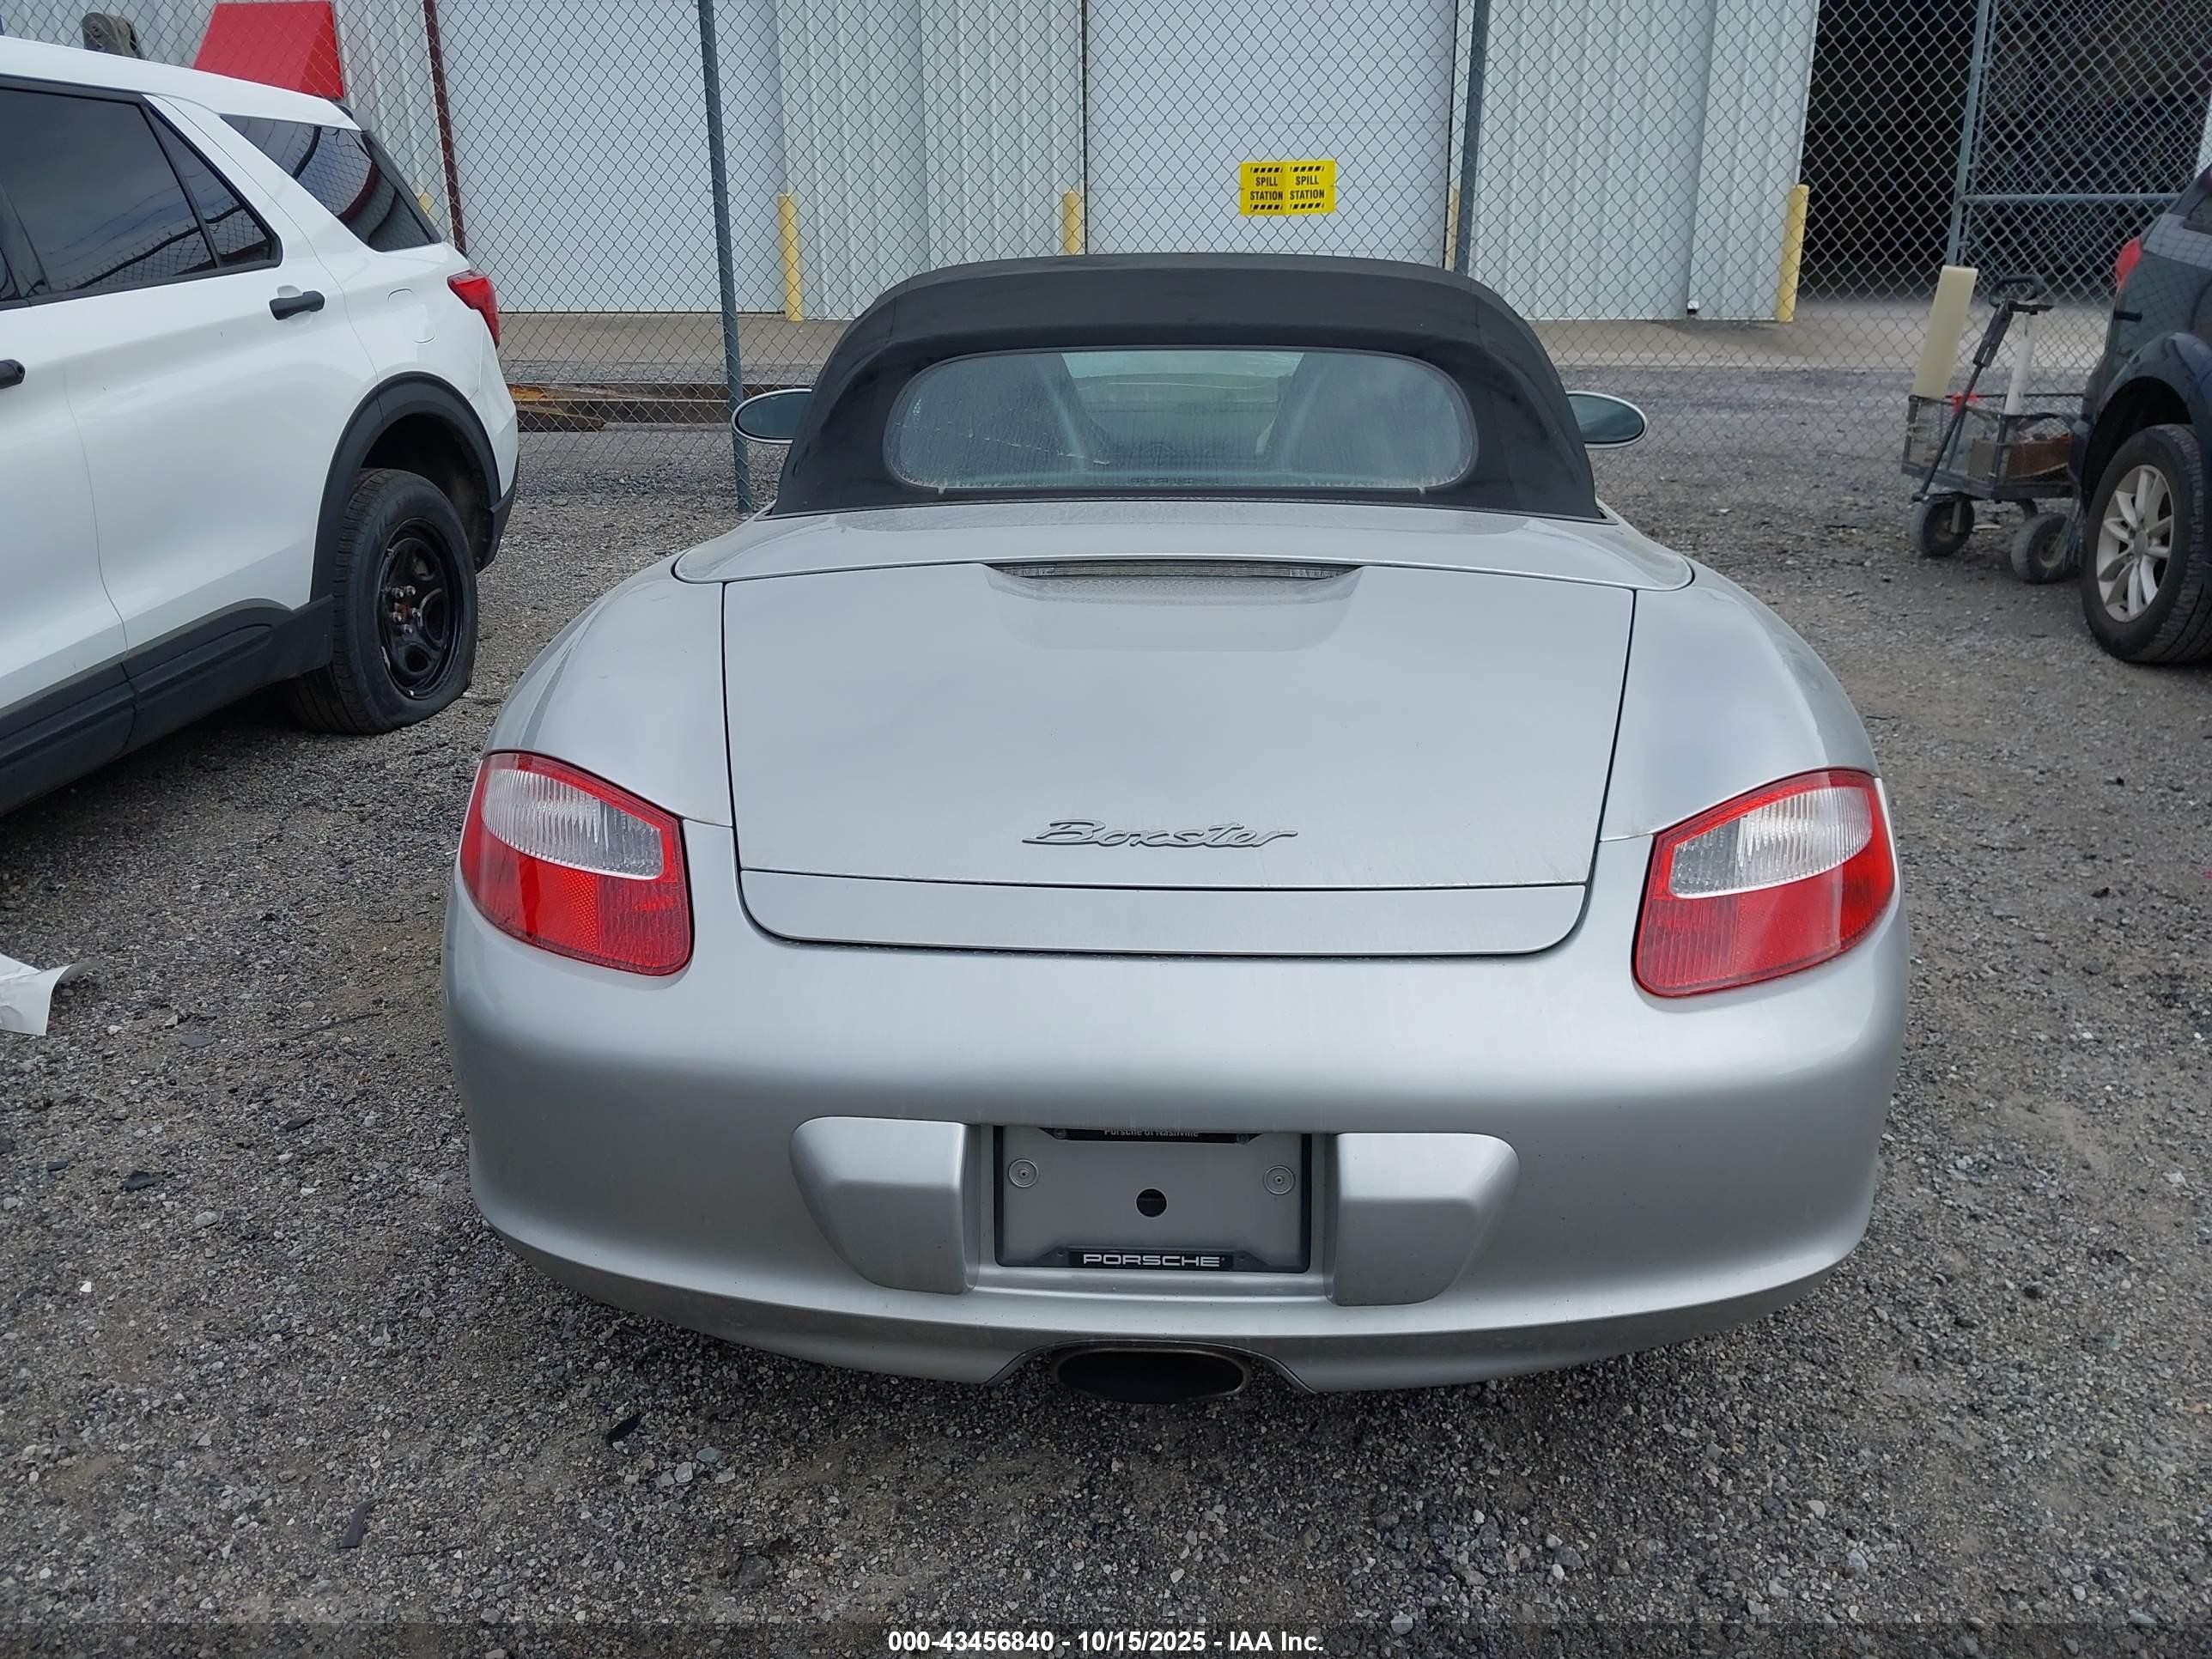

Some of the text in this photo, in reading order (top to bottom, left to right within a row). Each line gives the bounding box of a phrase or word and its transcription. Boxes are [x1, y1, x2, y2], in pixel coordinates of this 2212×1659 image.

[1255, 176, 1278, 186] SPILL
[1295, 175, 1319, 185] SPILL
[1249, 191, 1284, 200] STATION
[1290, 189, 1325, 200] STATION
[1022, 818, 1297, 848] Boxster
[1083, 1254, 1220, 1267] PORSCHE
